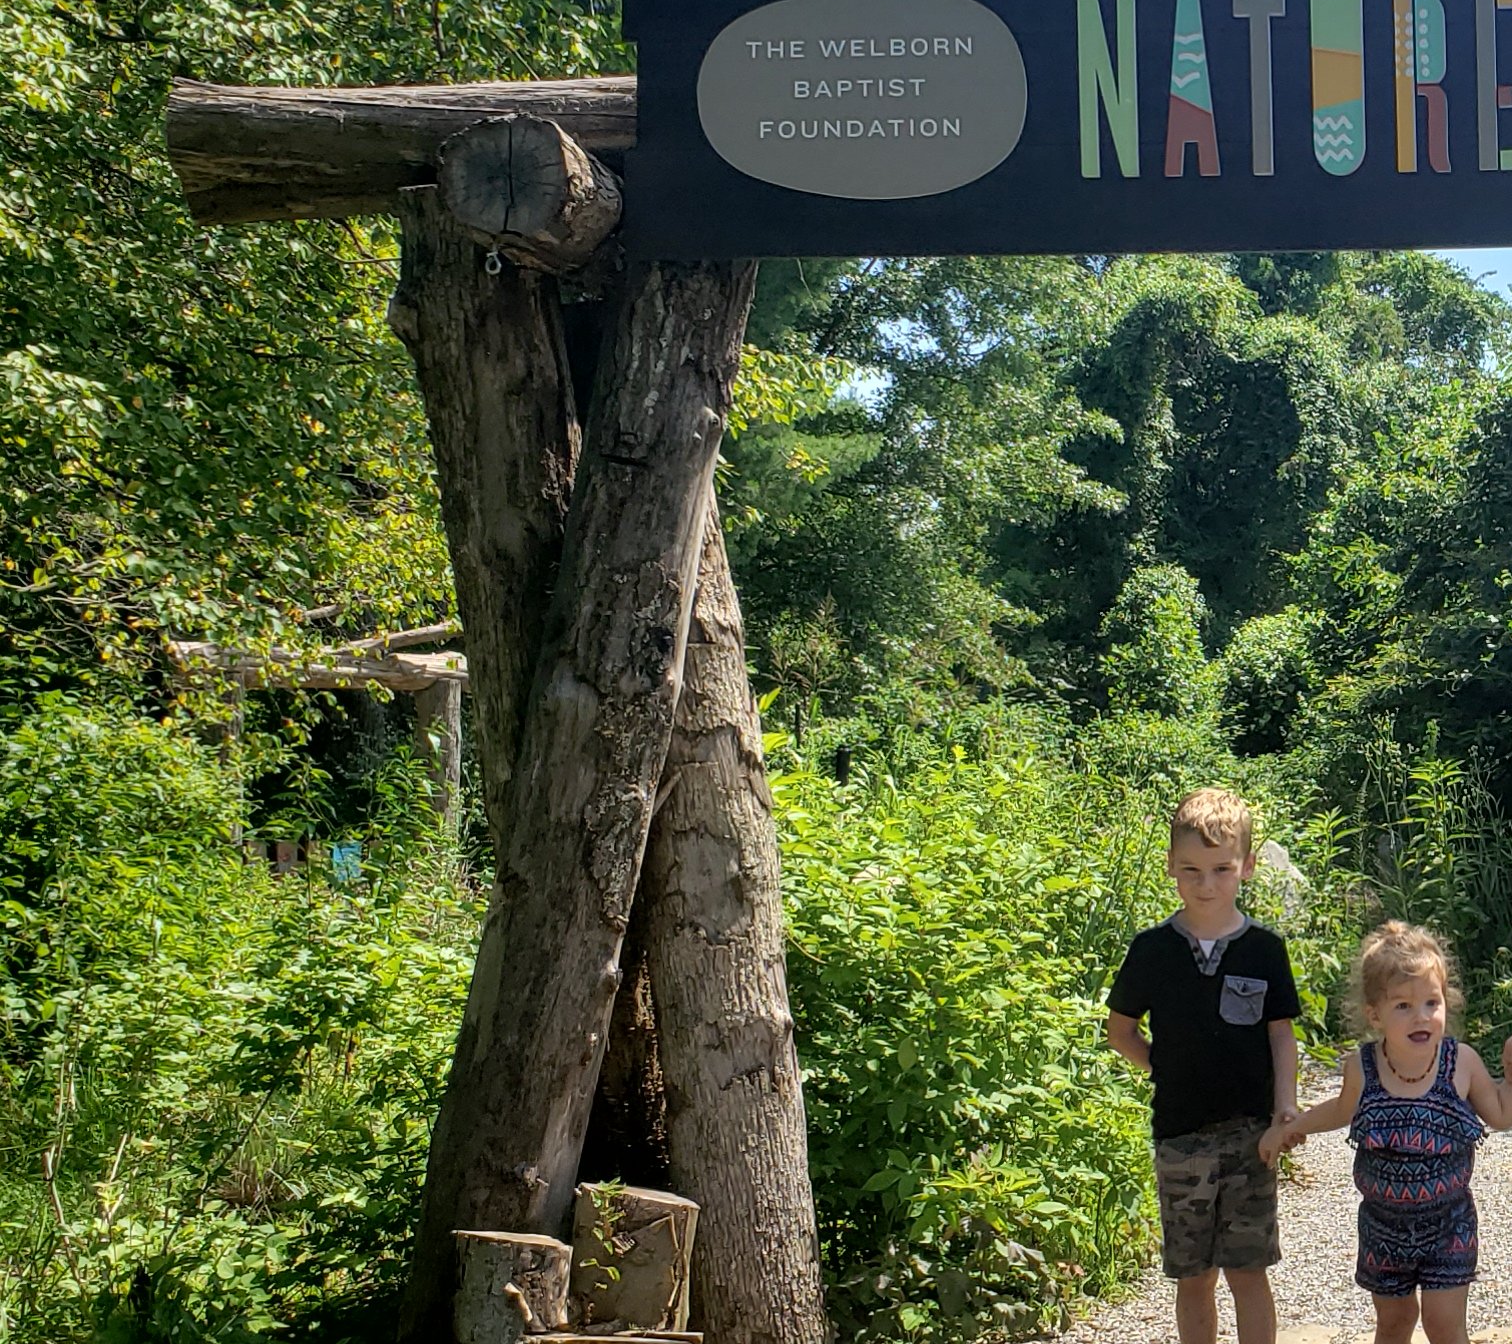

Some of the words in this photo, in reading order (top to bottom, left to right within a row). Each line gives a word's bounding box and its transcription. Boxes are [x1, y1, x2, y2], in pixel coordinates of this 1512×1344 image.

[745, 40, 806, 59] THE
[818, 37, 974, 58] WELBORN
[793, 78, 927, 99] BAPTIST
[758, 118, 962, 140] FOUNDATION
